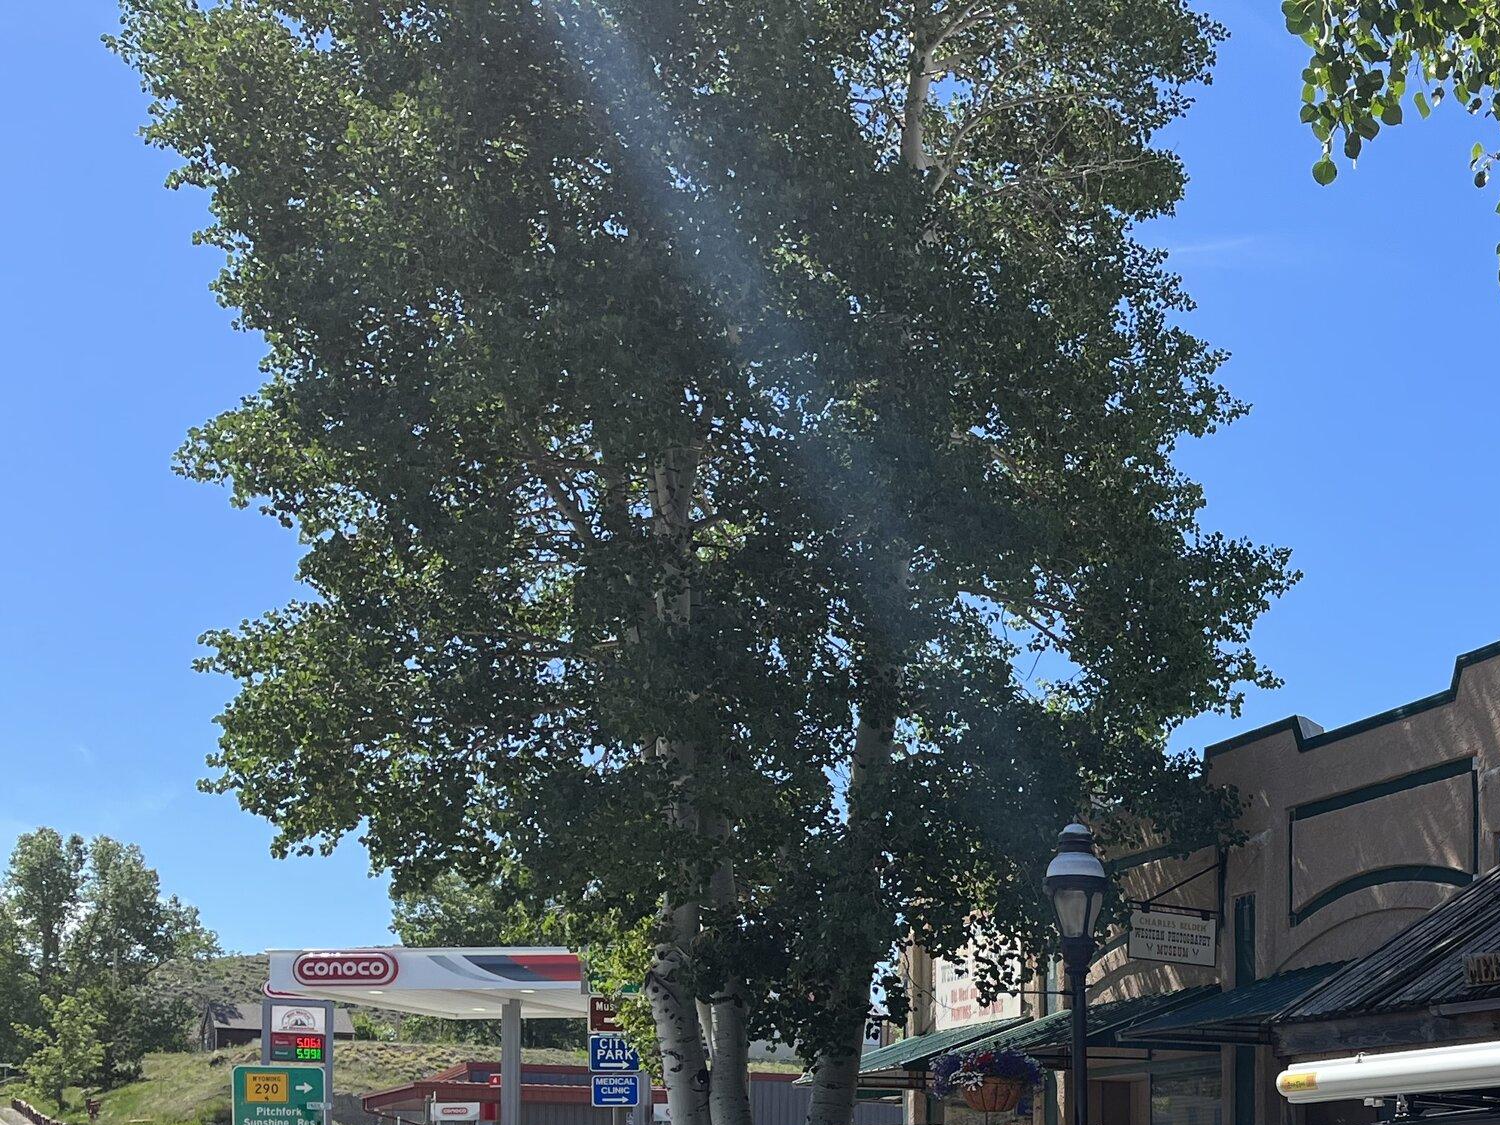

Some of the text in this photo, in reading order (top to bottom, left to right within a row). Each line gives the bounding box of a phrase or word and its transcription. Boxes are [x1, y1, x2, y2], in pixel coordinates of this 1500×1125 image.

[1135, 927, 1165, 941] WESTERN
[1157, 944, 1189, 958] MUSEUM
[596, 1001, 615, 1011] Mus
[597, 1050, 634, 1060] PARK
[255, 1084, 279, 1095] 290
[601, 1087, 630, 1095] CLINIC
[256, 1106, 302, 1116] Pitchfork
